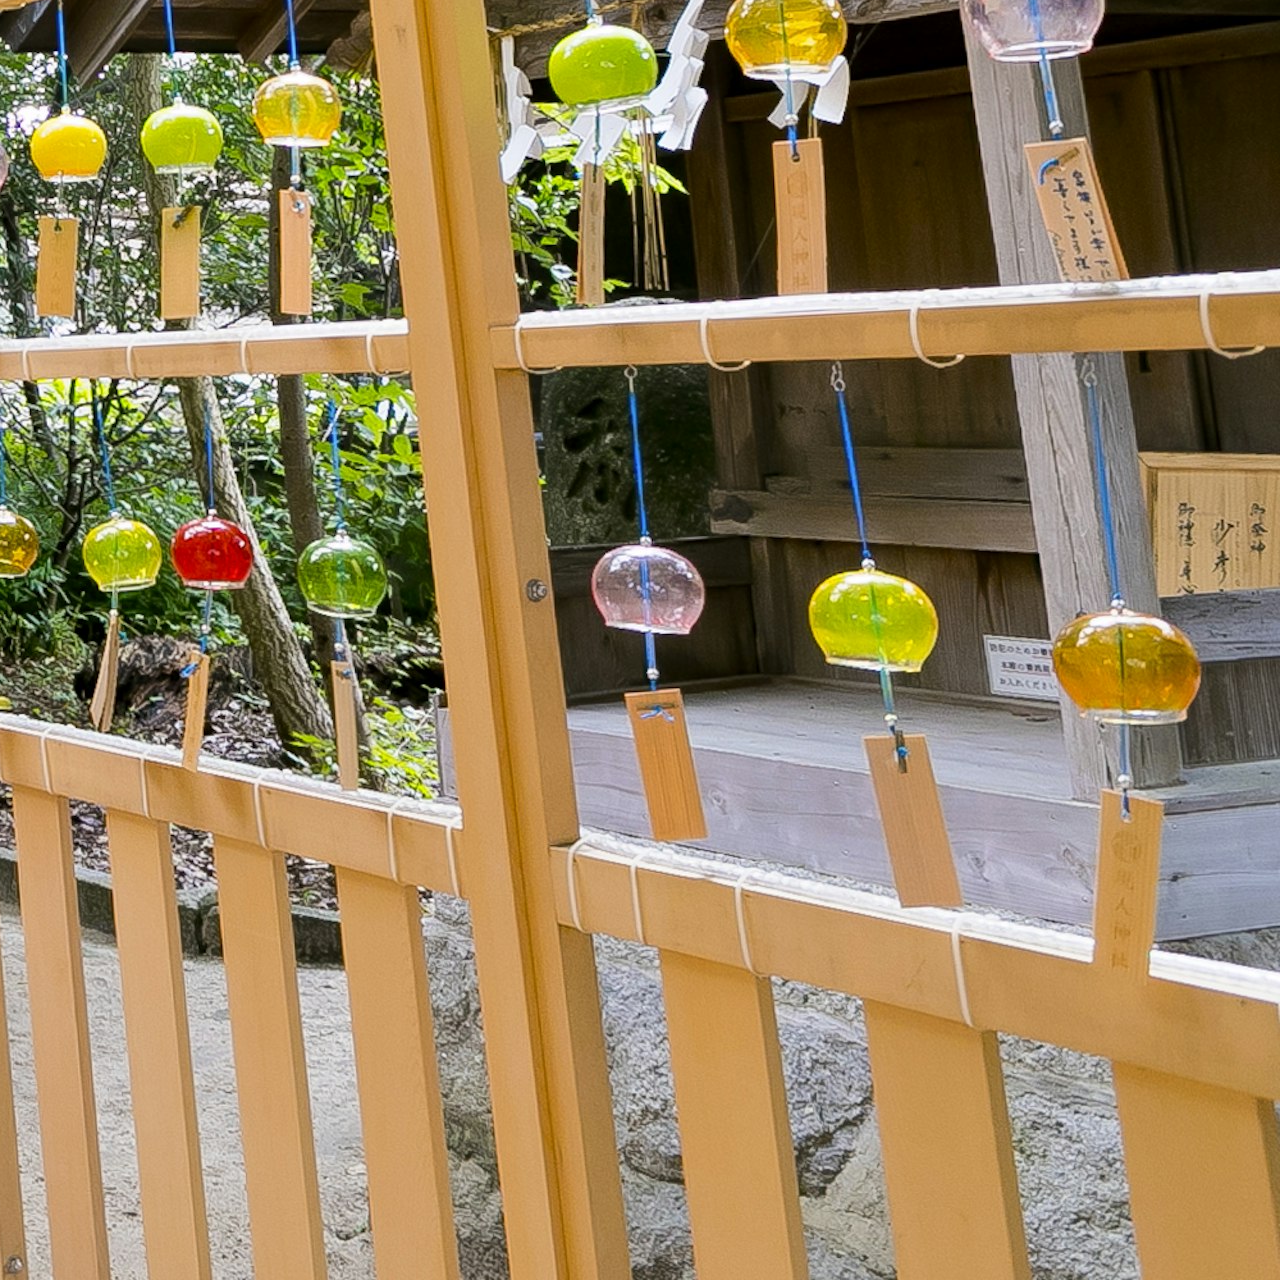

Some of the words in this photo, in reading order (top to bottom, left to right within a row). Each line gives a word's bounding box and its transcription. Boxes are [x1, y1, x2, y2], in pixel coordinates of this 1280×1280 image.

[791, 207, 811, 287] 現人神社
[1211, 518, 1235, 592] 少彦
